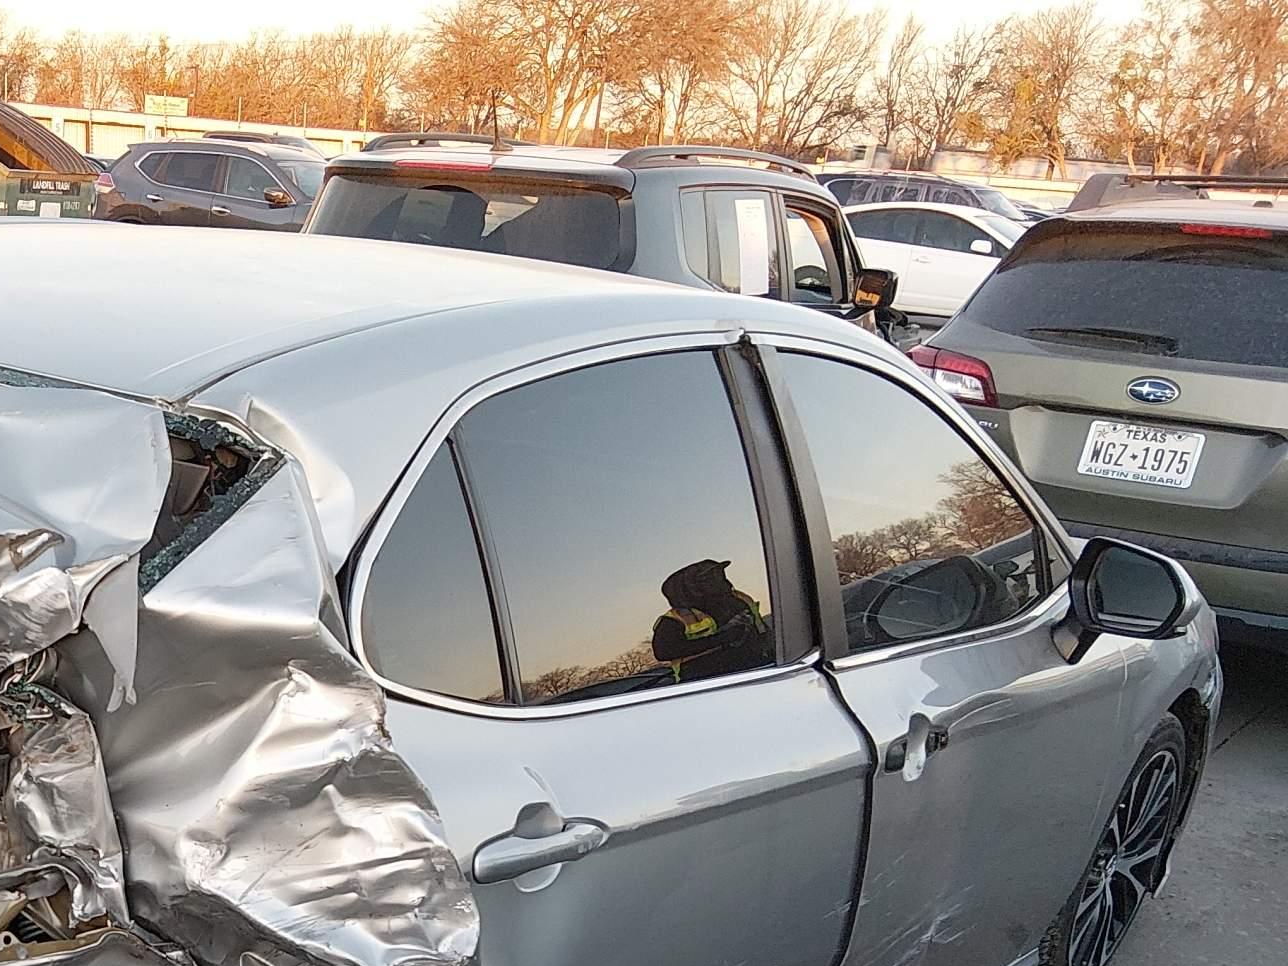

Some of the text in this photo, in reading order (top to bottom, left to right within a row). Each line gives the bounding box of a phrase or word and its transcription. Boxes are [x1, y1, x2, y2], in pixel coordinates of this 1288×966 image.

[32, 180, 71, 191] LANDFILL TRASH
[1126, 429, 1167, 444] TEXAS
[1085, 466, 1183, 487] AUSTIN SUBARU
